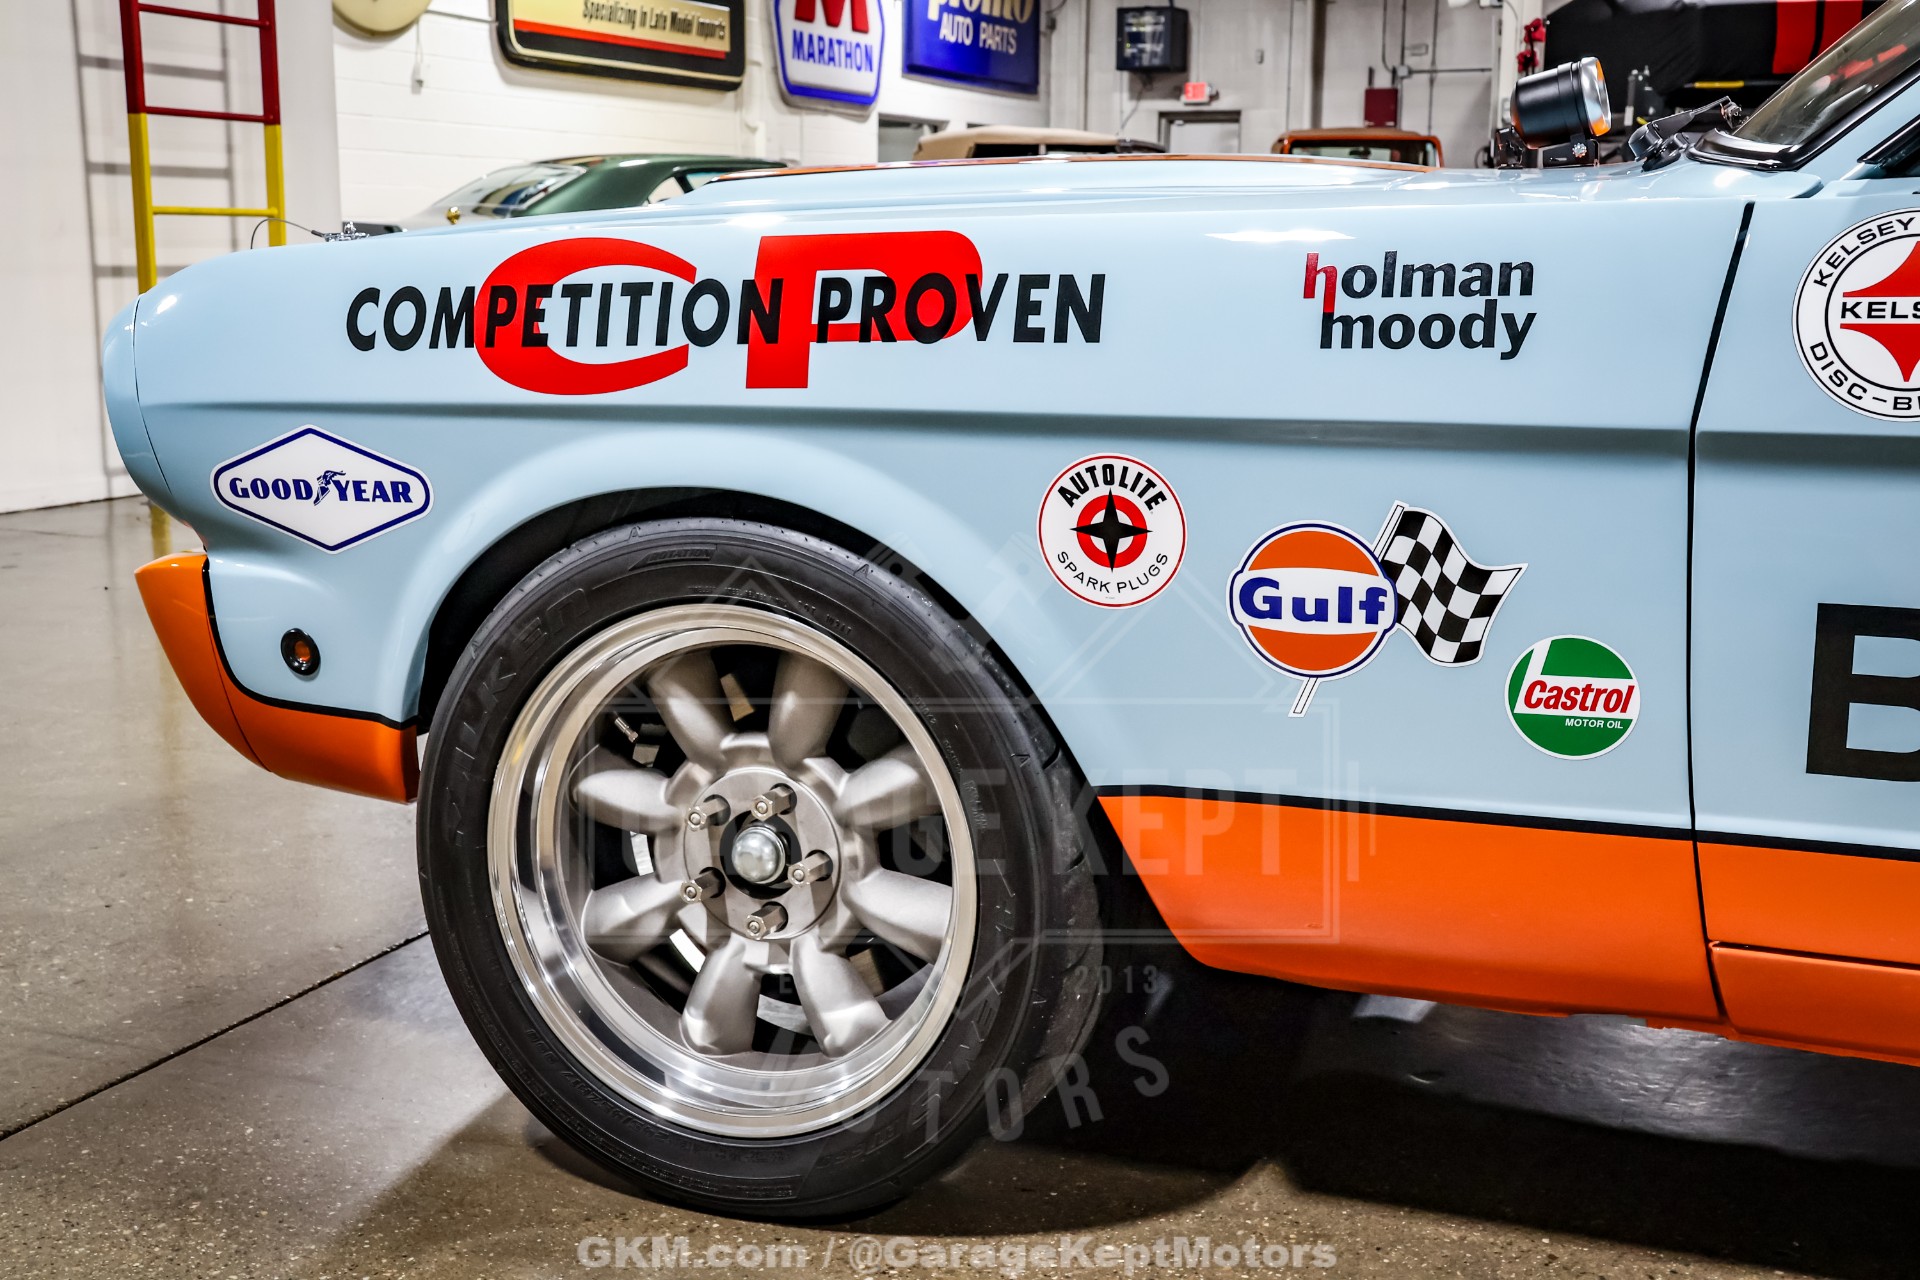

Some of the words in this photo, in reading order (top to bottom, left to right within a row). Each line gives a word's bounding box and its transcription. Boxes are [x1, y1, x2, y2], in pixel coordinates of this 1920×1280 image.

[650, 8, 668, 30] Late
[670, 11, 695, 34] Model
[939, 11, 974, 46] AUTO
[979, 21, 1018, 55] PARTS
[792, 29, 873, 73] MARATHON
[1303, 250, 1534, 300] holman
[1813, 216, 1916, 288] KELSEY
[346, 278, 784, 351] COMPETITION
[816, 272, 1106, 345] PROVEN
[1320, 299, 1537, 360] moody
[1057, 463, 1167, 511] AUTOLITE
[1057, 551, 1110, 593] SPARK
[1117, 553, 1168, 593] PLUGS
[1239, 577, 1387, 625] Gulf
[1523, 680, 1635, 714] Castrol
[1806, 603, 1920, 782] B
[1565, 718, 1604, 728] MOTOR
[1607, 720, 1623, 729] OIL
